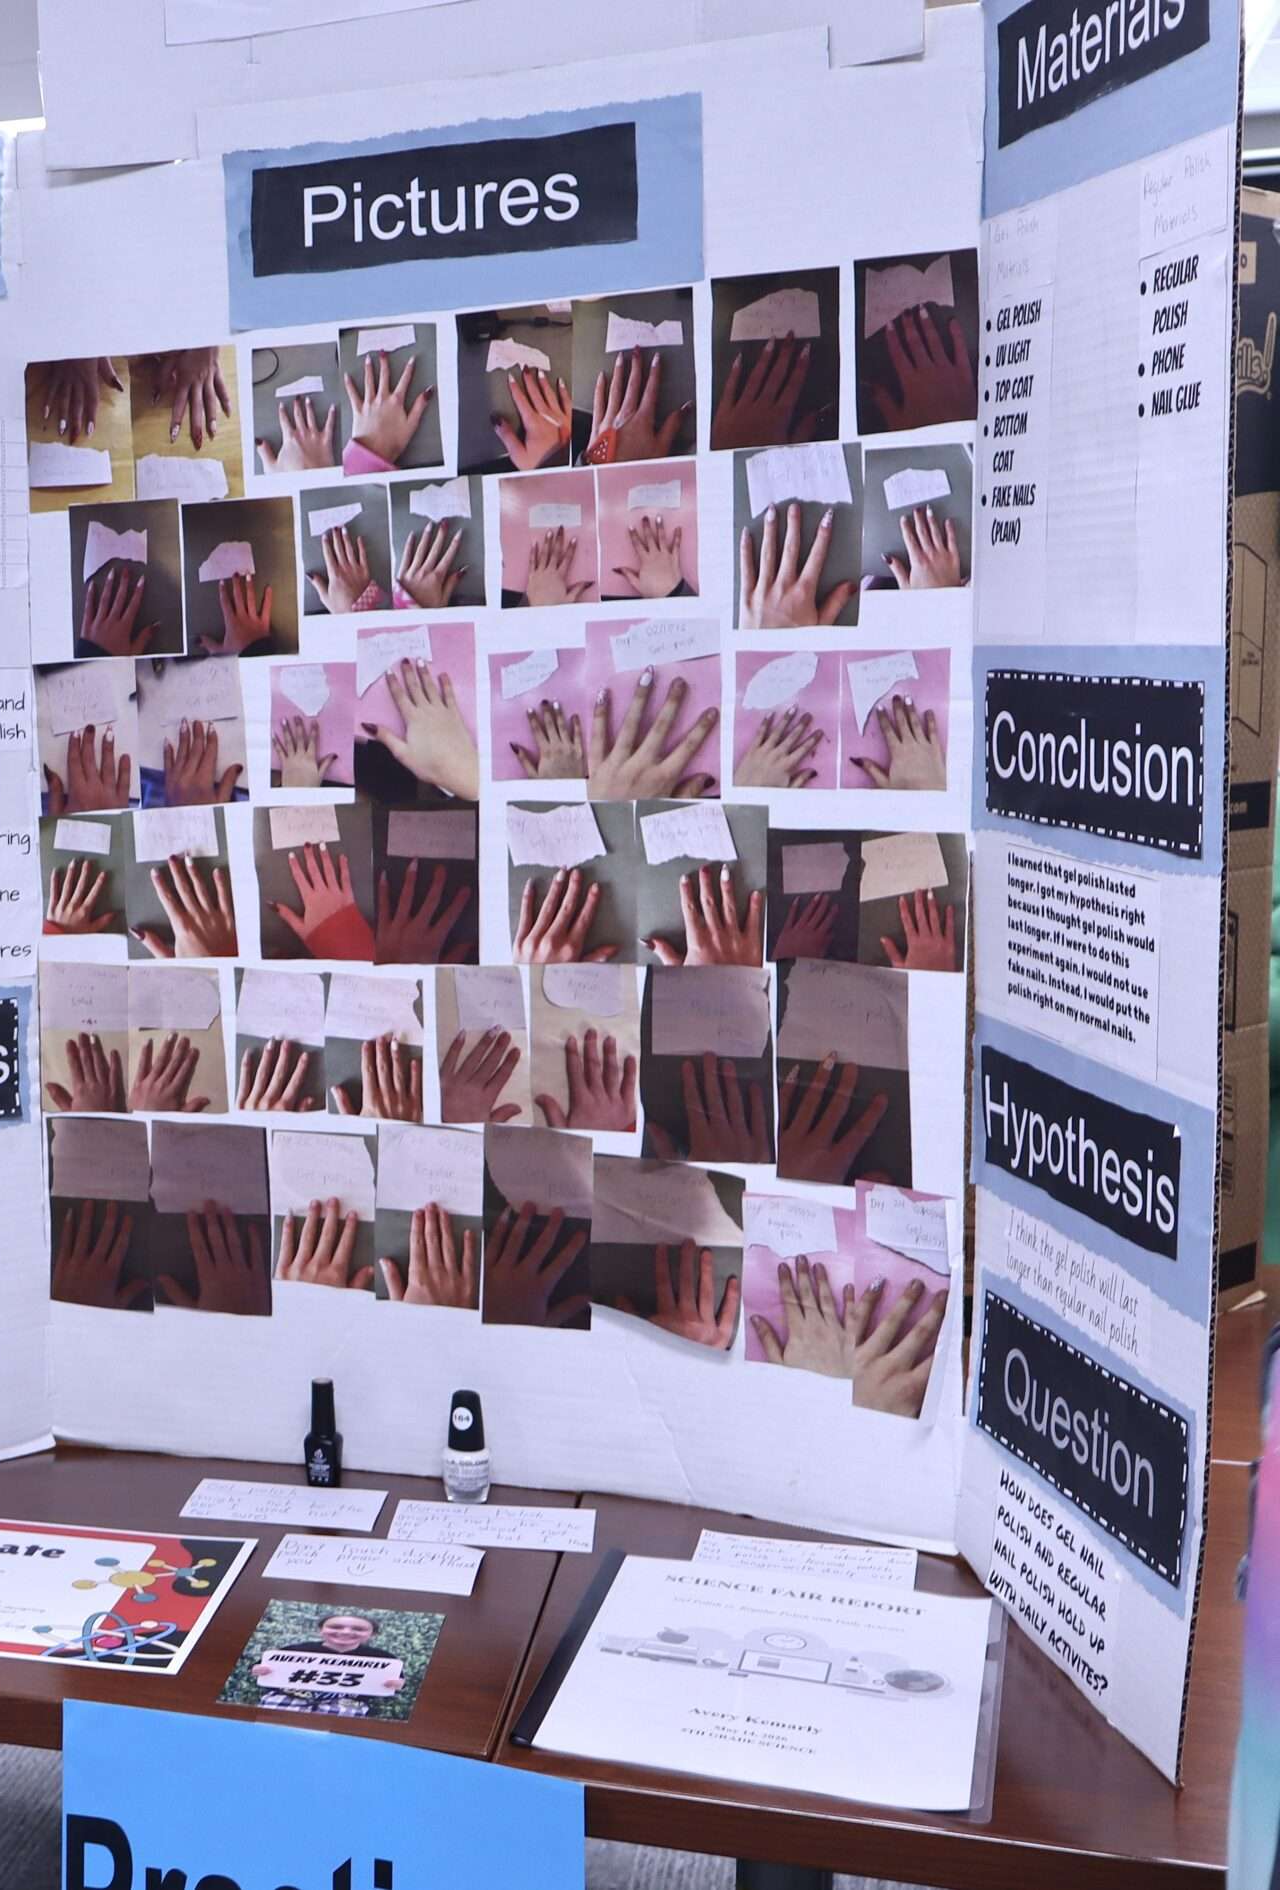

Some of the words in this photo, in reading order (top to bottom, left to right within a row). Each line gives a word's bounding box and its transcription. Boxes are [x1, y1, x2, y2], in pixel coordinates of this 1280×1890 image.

[302, 172, 581, 248] Pictures
[1153, 254, 1200, 295] REGULAR
[996, 306, 1011, 333] GEL
[1011, 299, 1042, 328] POLISH
[1152, 300, 1189, 336] POLISH
[995, 344, 1007, 368] UV
[1007, 339, 1031, 365] LIGHT
[1151, 344, 1186, 377] PHONE
[995, 379, 1011, 403] TOP
[1011, 375, 1034, 400] COAT
[1151, 388, 1173, 418] NAIL
[1175, 381, 1202, 411] GLUE
[993, 412, 1028, 439] BOTTOM
[992, 450, 1015, 474] COAT
[991, 486, 1012, 508] FAKE
[1012, 484, 1036, 507] NAILS
[991, 517, 1021, 546] (PLAIN)
[992, 710, 1194, 807] Conclusion
[1011, 853, 1043, 874] learned
[1043, 861, 1063, 879] that
[1063, 868, 1077, 884] gel
[1077, 872, 1105, 891] polish
[1106, 878, 1136, 898] lasted
[1007, 873, 1036, 894] longer.
[1040, 885, 1056, 900] got
[1056, 892, 1069, 905] my
[1069, 890, 1119, 917] hypothesis
[1120, 905, 1146, 927] right
[984, 1074, 1175, 1234] Hypothesis
[1008, 1209, 1015, 1237] I
[1015, 1215, 1038, 1253] think
[1039, 1229, 1054, 1262] the
[1054, 1243, 1069, 1277] gel
[1069, 1252, 1097, 1288] polish
[1099, 1271, 1118, 1304] will
[1119, 1279, 1139, 1318] last
[1004, 1348, 1154, 1518] Question
[999, 1468, 1026, 1505] HOW
[1028, 1496, 1055, 1530] DOES
[1055, 1524, 1076, 1553] GEL
[1079, 1544, 1105, 1580] NAIL
[997, 1504, 1032, 1548] POLISH
[1034, 1541, 1054, 1568] AND
[1057, 1562, 1106, 1622] REGULAR
[664, 1573, 764, 1594] SCIENCE
[771, 1586, 823, 1602] FAIR
[831, 1592, 928, 1616] REPORT
[994, 1538, 1017, 1570] NAIL
[1019, 1562, 1055, 1608] POLISH
[1057, 1603, 1086, 1637] HOLD
[1088, 1635, 1106, 1655] UP
[988, 1570, 1016, 1605] WITH
[1019, 1598, 1048, 1635] DAILY
[1048, 1629, 1109, 1697] ACTIVITES?
[268, 1653, 318, 1665] AVERY
[318, 1657, 392, 1670] KEMARLY
[288, 1668, 365, 1688] #33
